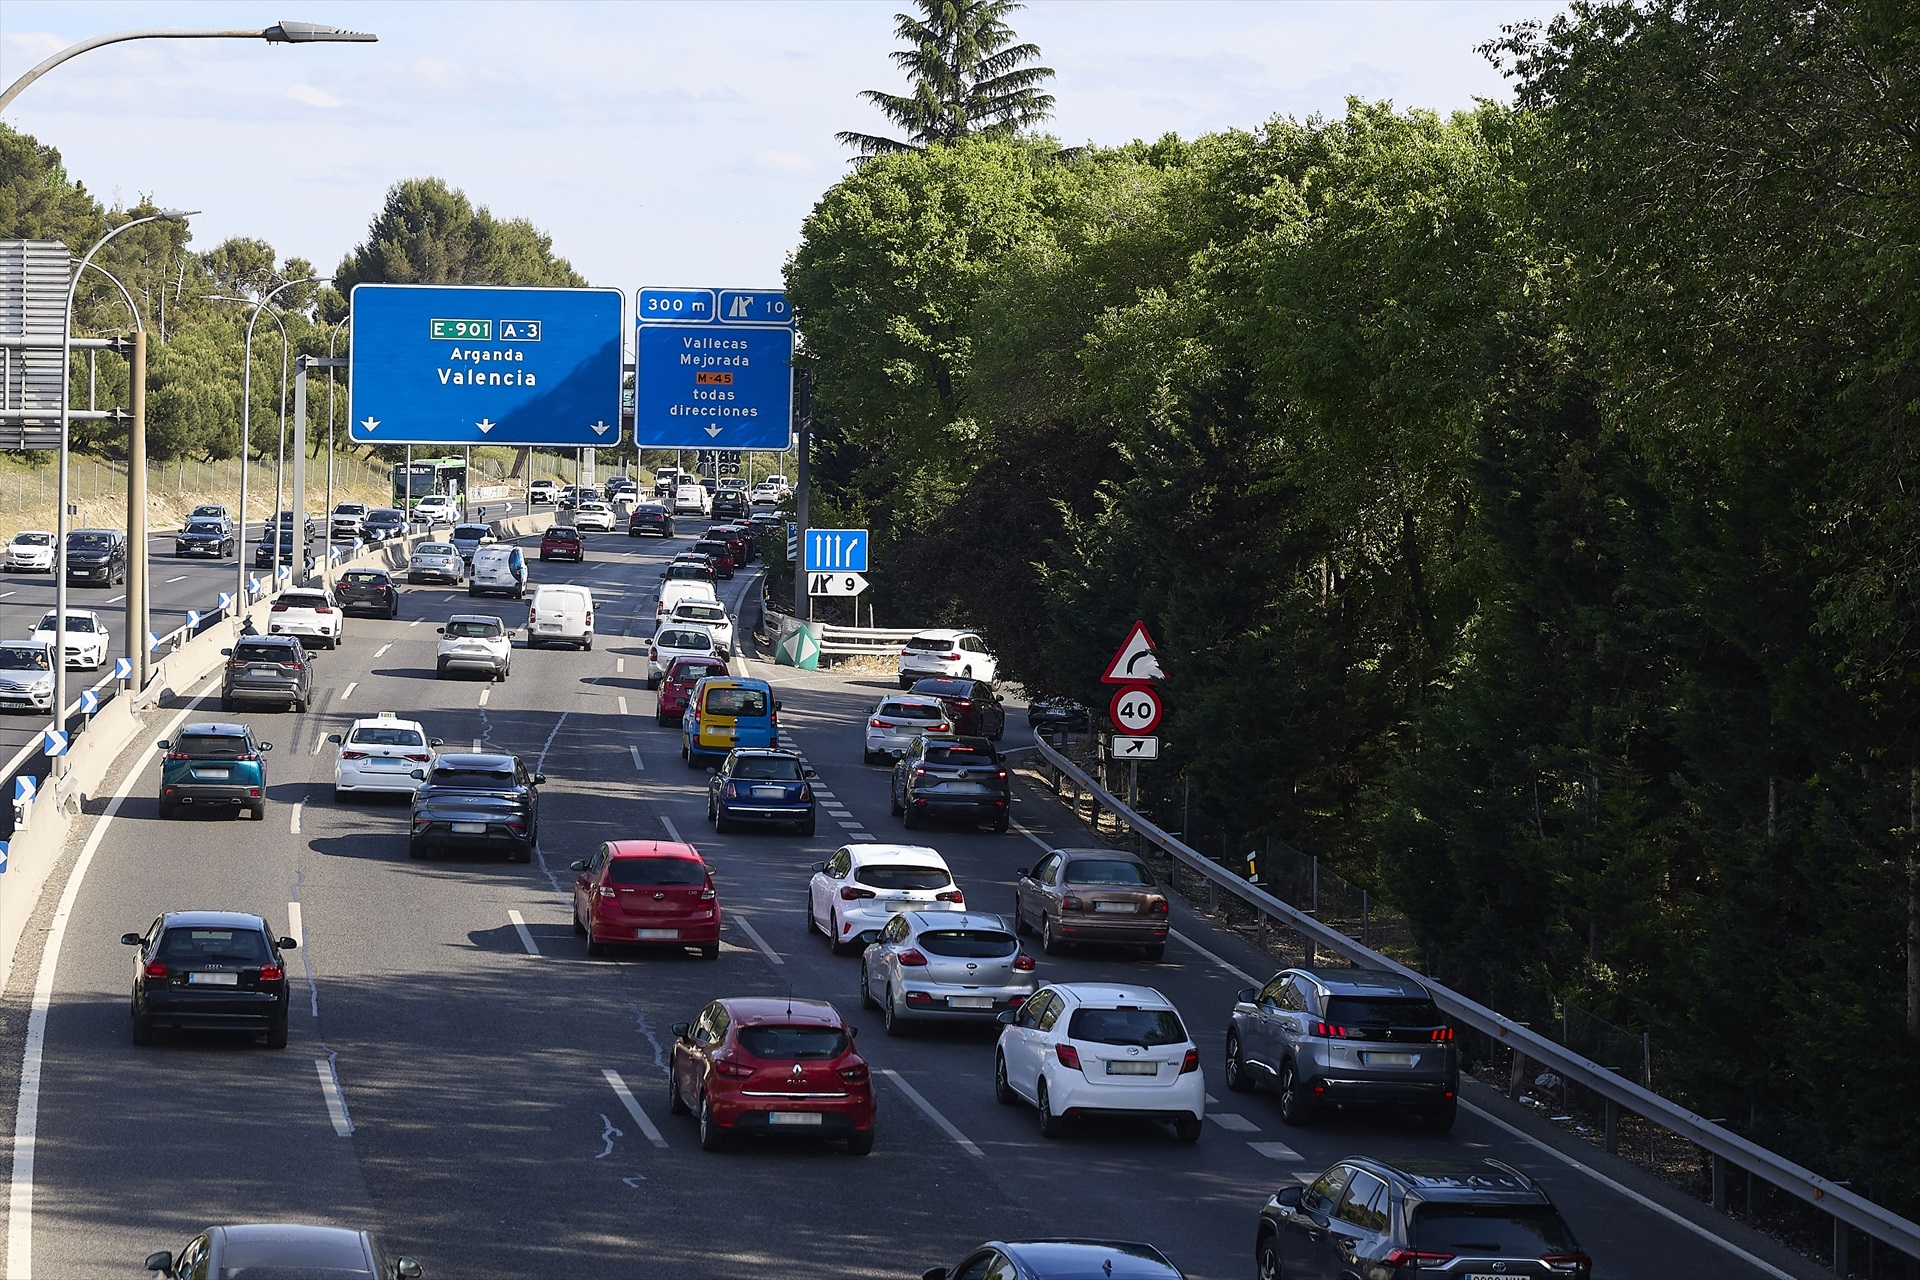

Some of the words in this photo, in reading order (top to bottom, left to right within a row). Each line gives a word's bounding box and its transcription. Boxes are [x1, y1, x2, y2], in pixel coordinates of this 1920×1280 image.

[647, 298, 683, 312] 300
[691, 301, 705, 312] m
[766, 301, 785, 313] 10
[433, 322, 489, 337] E-901
[503, 323, 538, 338] A-3
[682, 337, 748, 349] Vallecas
[450, 347, 524, 365] Arganda
[680, 353, 750, 368] Mejorada
[437, 368, 536, 386] Valencia
[697, 373, 732, 383] M-45
[693, 388, 735, 401] todas
[669, 404, 758, 417] direcciones
[844, 577, 855, 591] 9
[1120, 702, 1152, 719] 40
